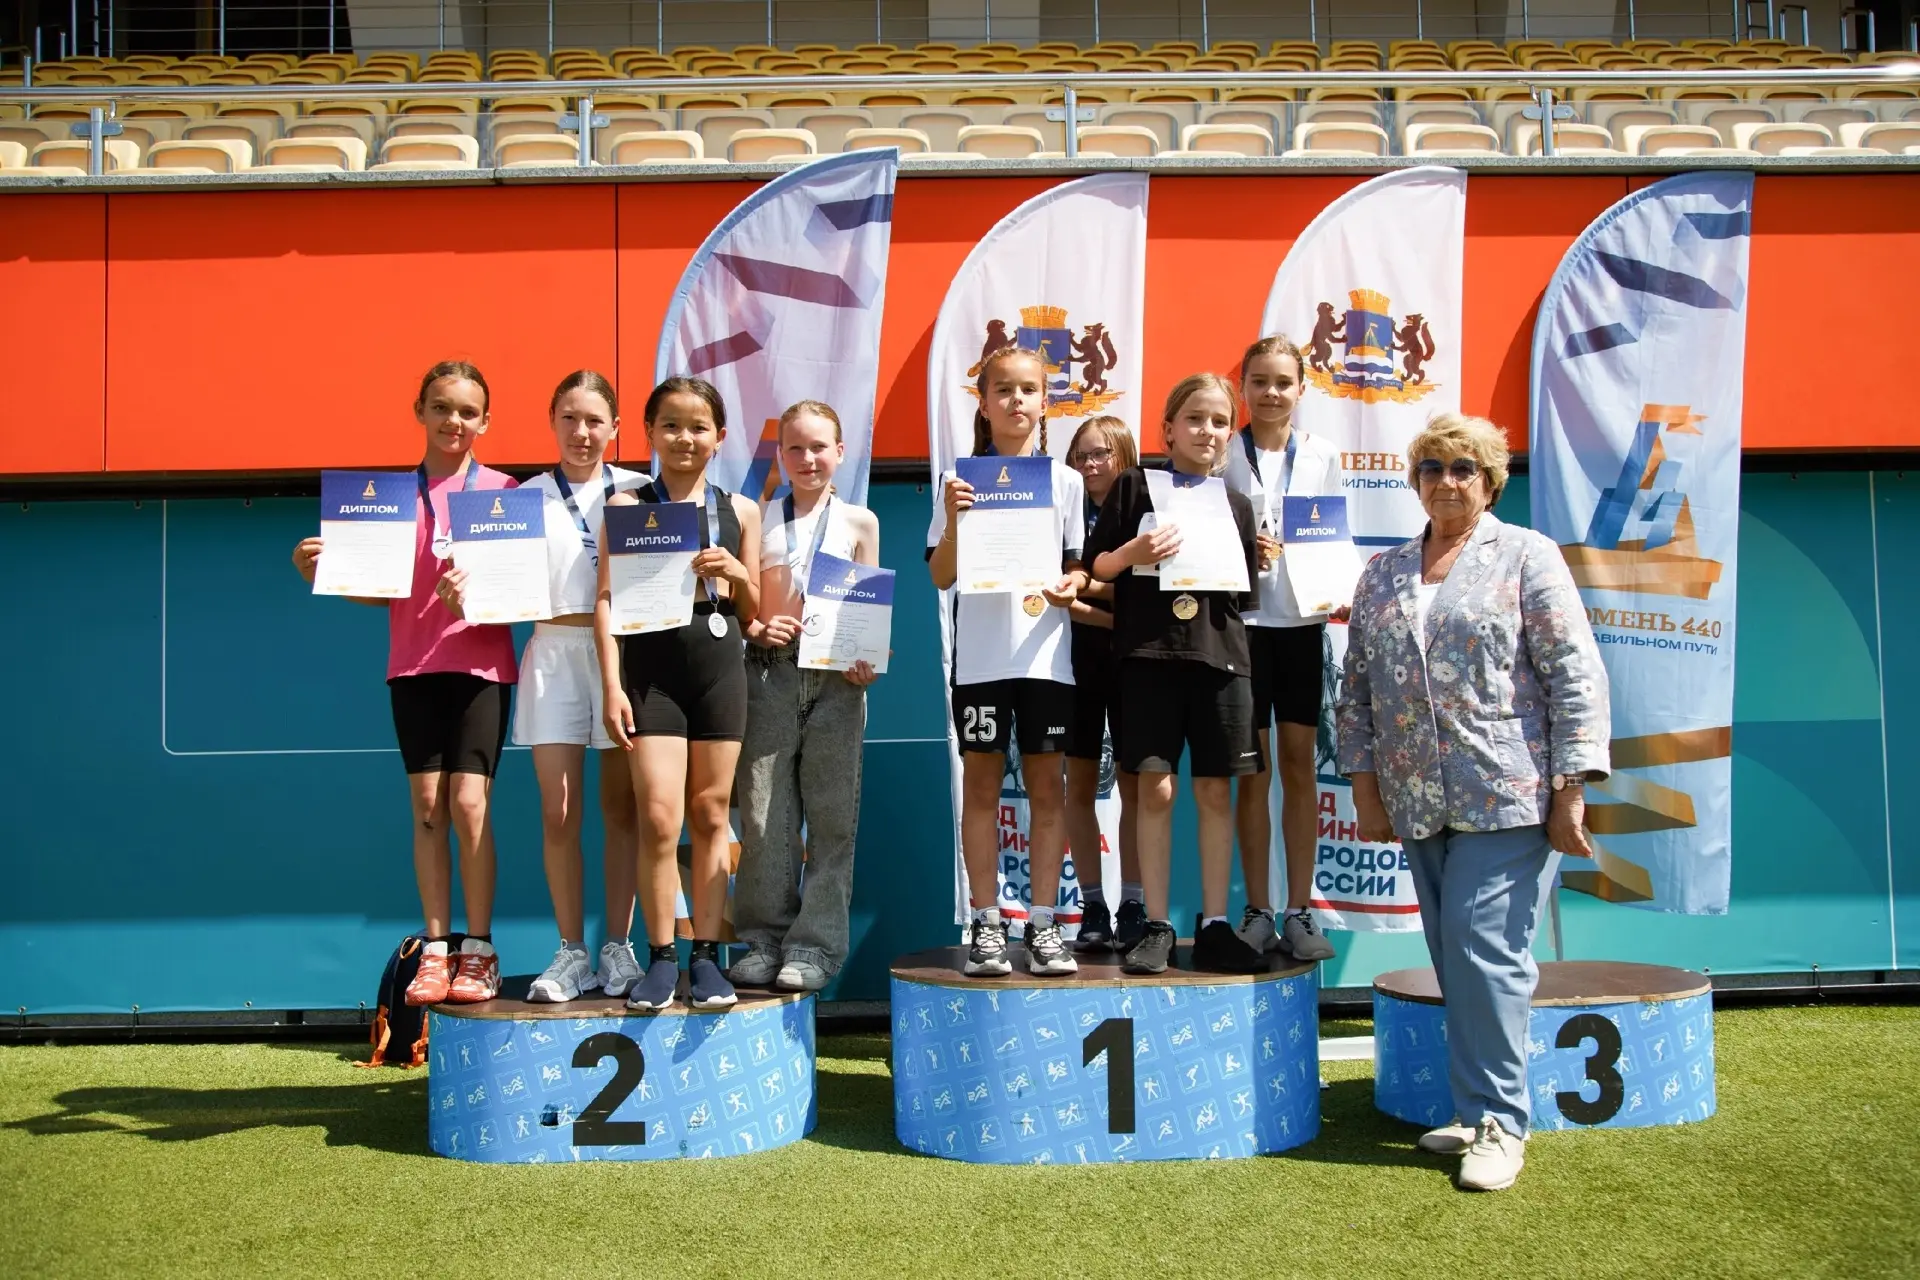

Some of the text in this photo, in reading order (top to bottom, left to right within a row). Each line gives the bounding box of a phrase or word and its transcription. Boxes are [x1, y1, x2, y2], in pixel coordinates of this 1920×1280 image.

[1340, 452, 1406, 471] ЕНЬ
[975, 492, 1034, 502] ДИПЛОМ
[339, 504, 399, 514] ДИПЛОМ
[470, 522, 528, 534] ДИПЛОМ
[1296, 527, 1337, 537] ДИПЛОМ
[625, 534, 682, 548] ДИПЛОМ
[823, 584, 876, 599] ДИПЛОМ
[1584, 607, 1722, 639] МЕНЬ 440
[1593, 633, 1718, 656] АВИЛЬНОМ ПУТИ
[963, 706, 997, 742] 25
[1047, 726, 1066, 735] JAKO
[1315, 845, 1411, 873] РОДОВ
[1315, 871, 1396, 896] ССИИ
[1082, 1017, 1137, 1134] 1
[1554, 1013, 1625, 1124] 3
[571, 1031, 646, 1146] 2
